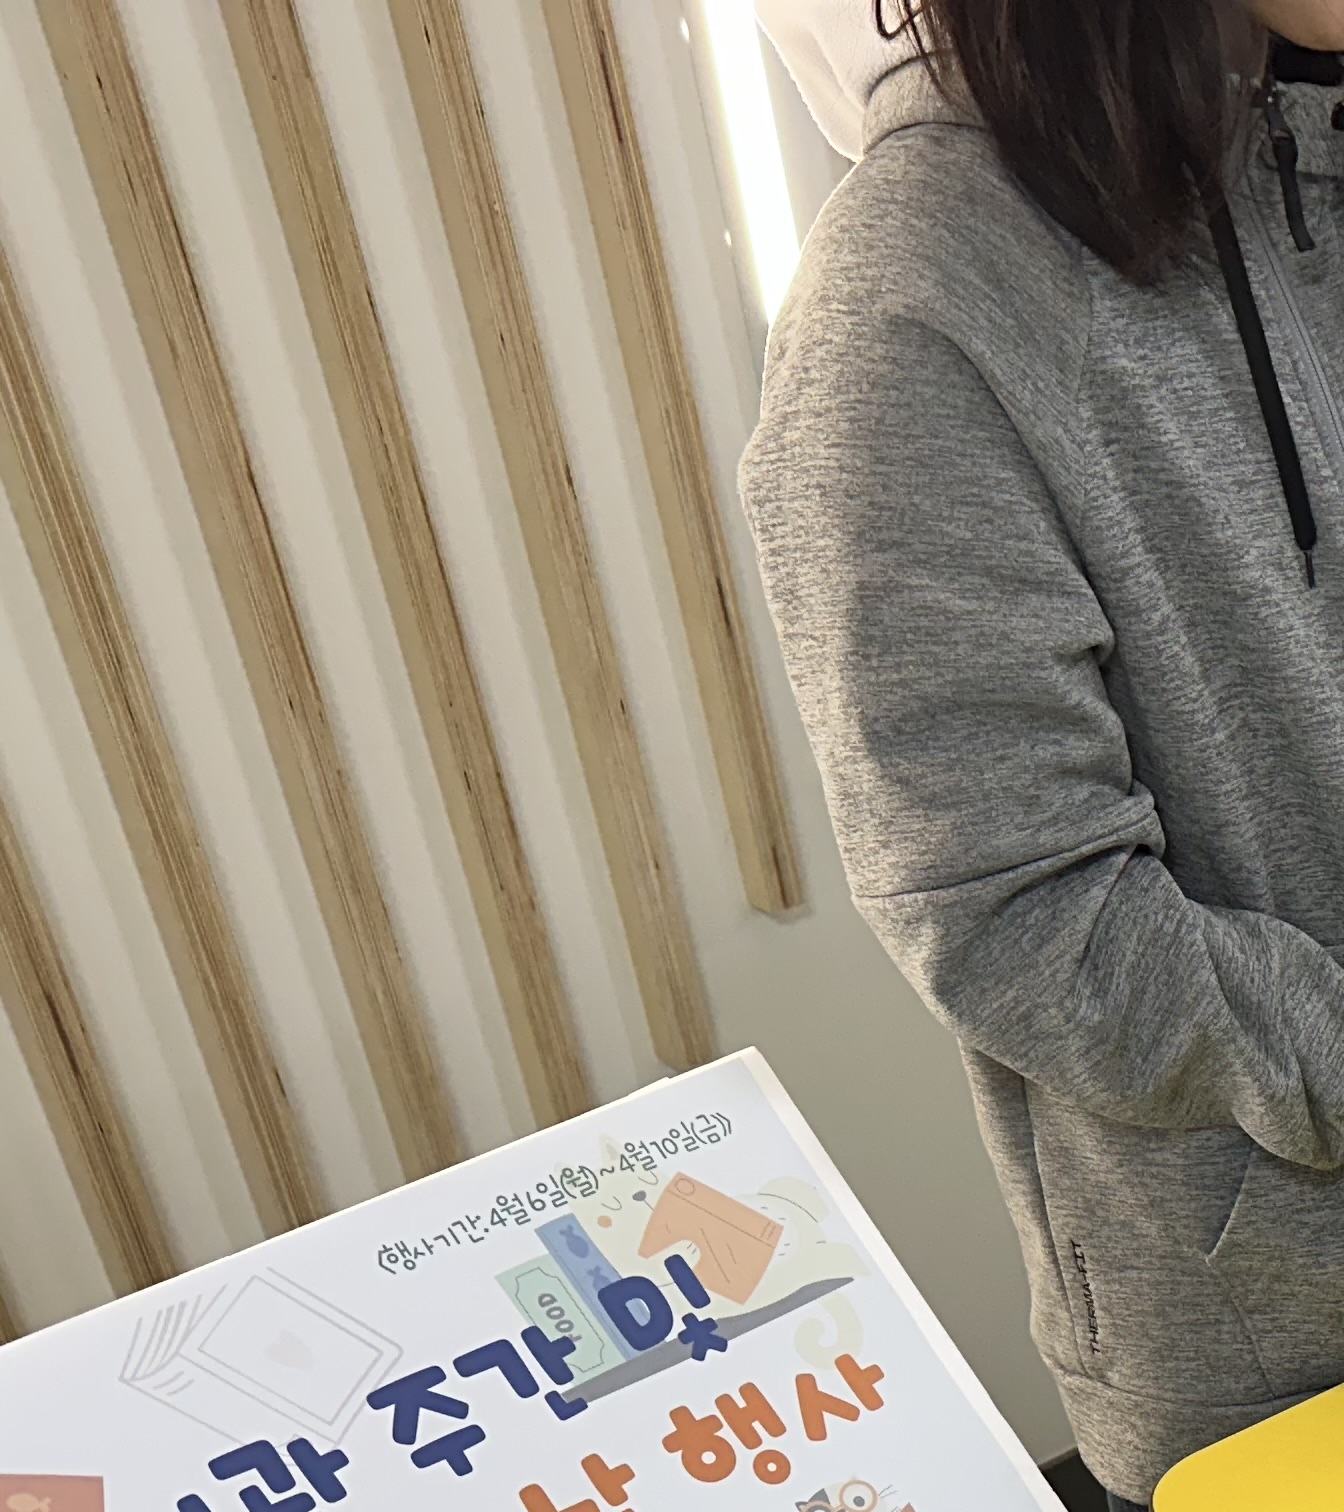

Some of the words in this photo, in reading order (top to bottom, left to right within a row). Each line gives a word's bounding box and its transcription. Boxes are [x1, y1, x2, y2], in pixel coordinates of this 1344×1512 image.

[368, 1324, 587, 1475] 주간
[597, 1254, 728, 1361] 및
[661, 1354, 885, 1486] 행사
